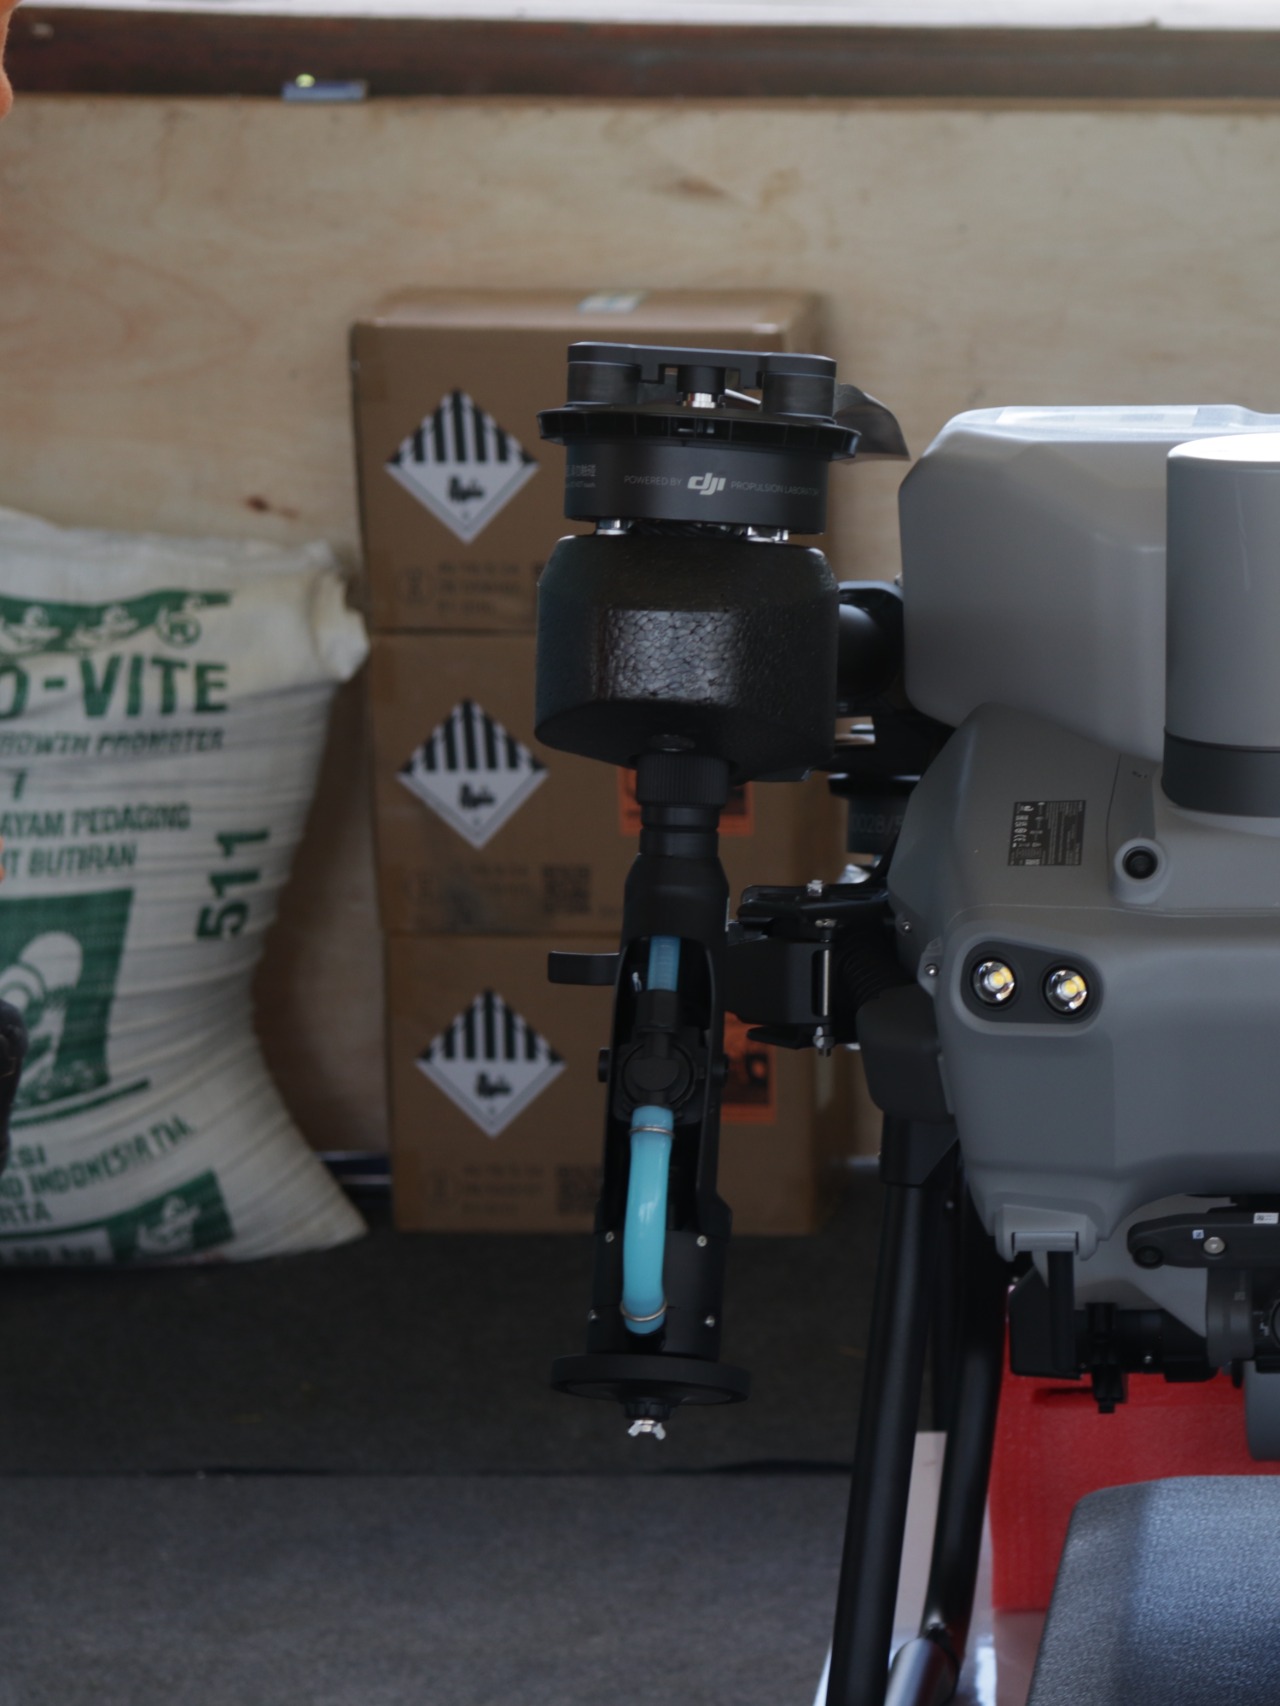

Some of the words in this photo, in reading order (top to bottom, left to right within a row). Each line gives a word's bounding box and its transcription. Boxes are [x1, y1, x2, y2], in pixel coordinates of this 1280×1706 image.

[624, 475, 667, 486] POWERED
[670, 477, 682, 487] BY
[731, 480, 783, 494] PROPULSION
[100, 728, 225, 756] PROMOTER
[72, 804, 192, 835] PEDAGING
[29, 843, 138, 878] BUTIRAN
[195, 828, 269, 941] 511
